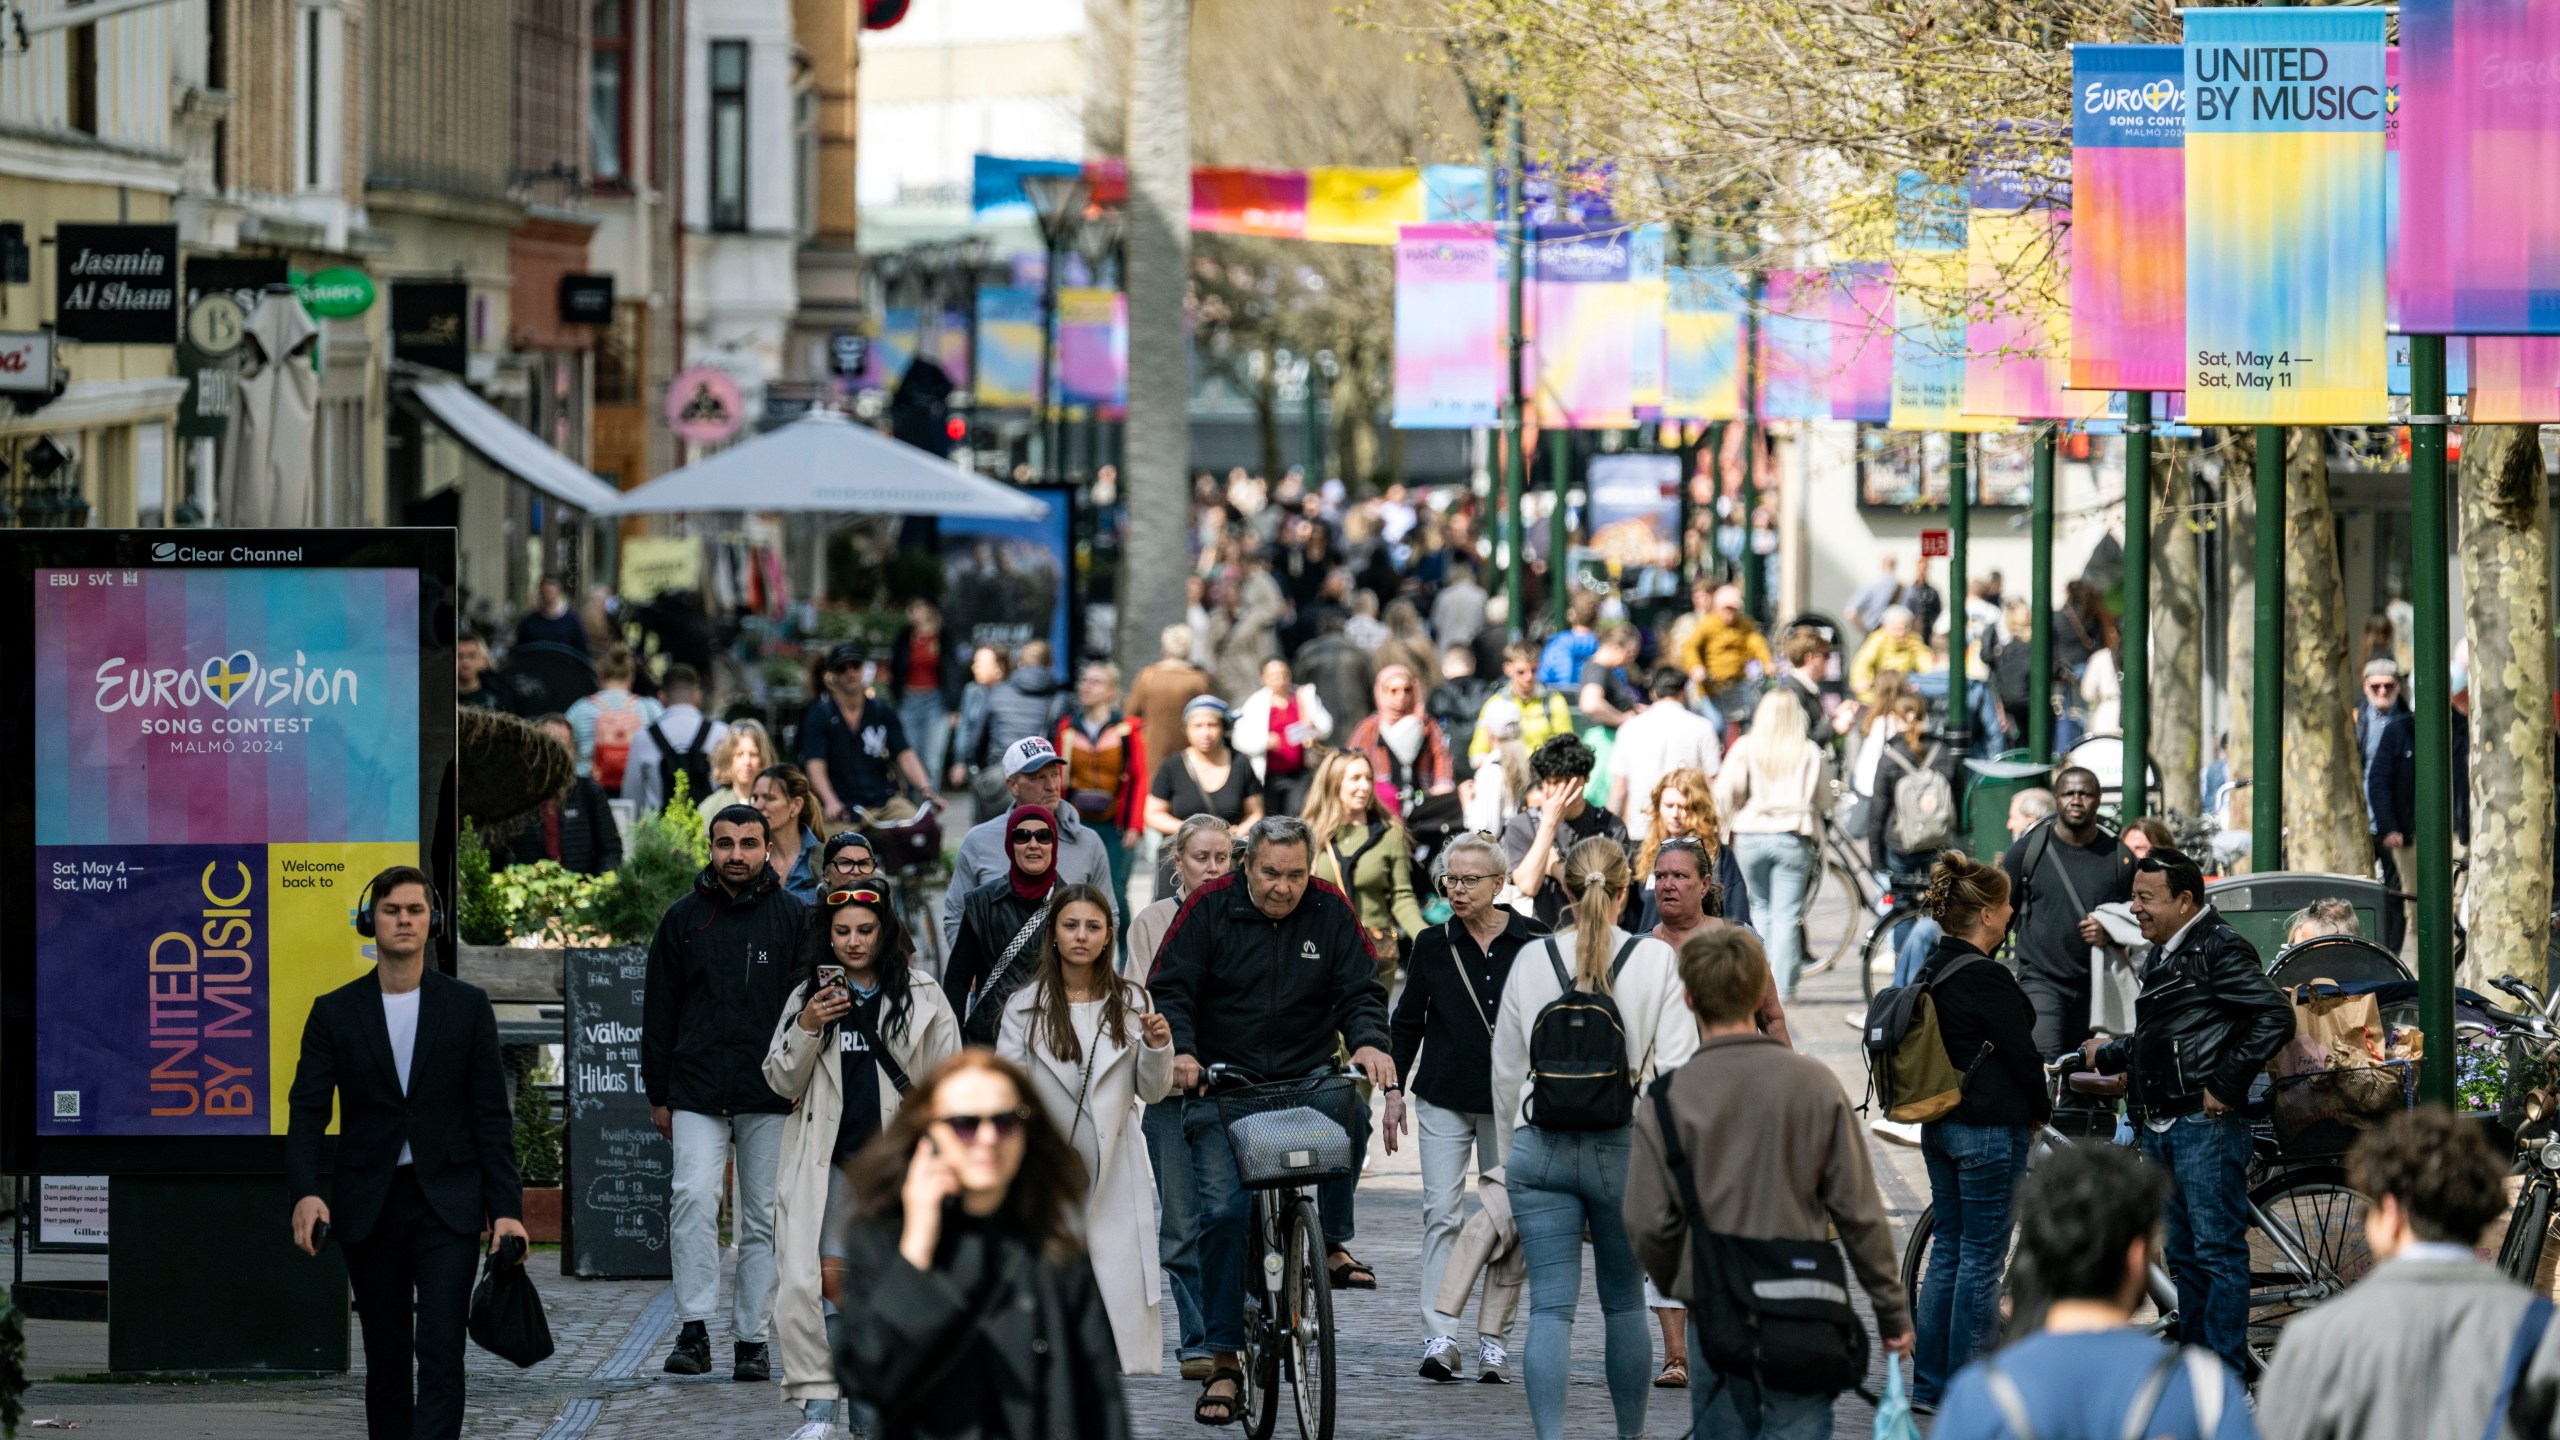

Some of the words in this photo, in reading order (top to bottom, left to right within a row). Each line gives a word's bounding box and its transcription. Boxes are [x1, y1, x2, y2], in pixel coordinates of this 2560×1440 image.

[2196, 47, 2329, 83] UNITED
[2197, 86, 2241, 121] BY
[2253, 85, 2379, 121] MUSIC
[2109, 116, 2144, 126] SONG
[70, 248, 165, 276] Jasmin
[63, 281, 97, 310] Al
[98, 281, 173, 310] Sham
[2198, 350, 2231, 368] Sat,
[2236, 350, 2274, 370] May
[2278, 350, 2290, 366] 4
[2198, 371, 2231, 389] Sat,
[2236, 371, 2274, 391] May
[2278, 371, 2291, 387] 11
[178, 546, 225, 562] Clear
[230, 546, 303, 562] Channel
[50, 574, 79, 586] EBU
[88, 571, 113, 586] svt
[141, 719, 203, 734] SONG
[211, 717, 313, 734] CONTEST
[170, 738, 235, 753] MALMÖ
[242, 740, 283, 753] 2024
[53, 861, 79, 876] Sat,
[82, 861, 113, 878] May
[116, 861, 126, 874] 4
[282, 860, 345, 873] Welcome
[53, 877, 79, 892] Sat,
[82, 877, 113, 894] May
[117, 877, 127, 890] 11
[282, 876, 315, 888] back
[318, 877, 333, 888] to
[201, 860, 253, 1038] MUSIC
[149, 931, 200, 1116] UNITED
[605, 1048, 617, 1061] in
[204, 1053, 254, 1116] BY
[579, 1063, 629, 1093] Hildas
[74, 1228, 101, 1236] Gillar
